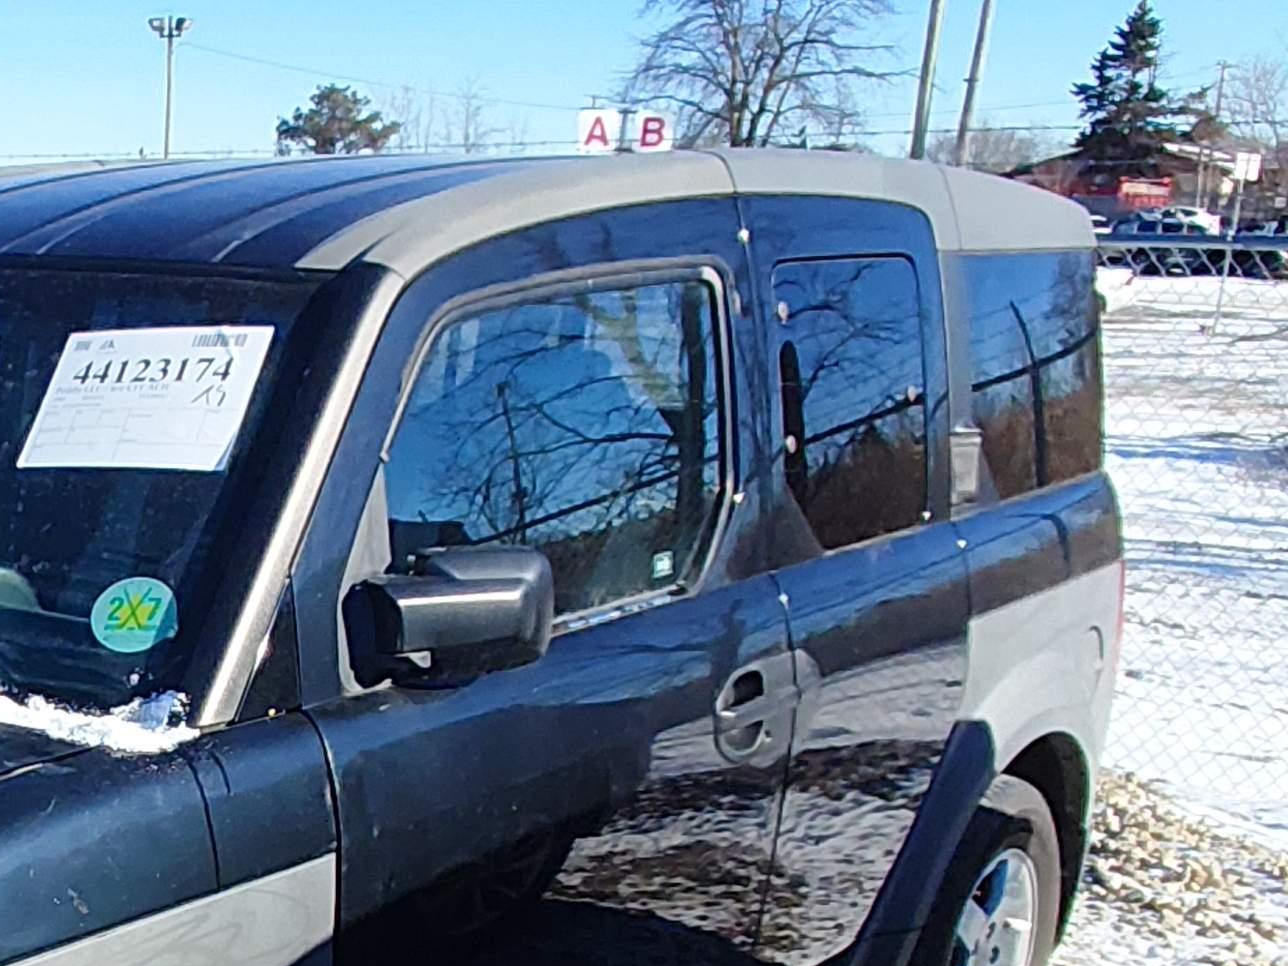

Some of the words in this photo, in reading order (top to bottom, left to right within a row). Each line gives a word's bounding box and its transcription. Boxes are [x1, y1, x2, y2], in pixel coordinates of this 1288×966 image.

[584, 116, 609, 146] A
[640, 117, 665, 147] B
[73, 357, 234, 384] 44123174
